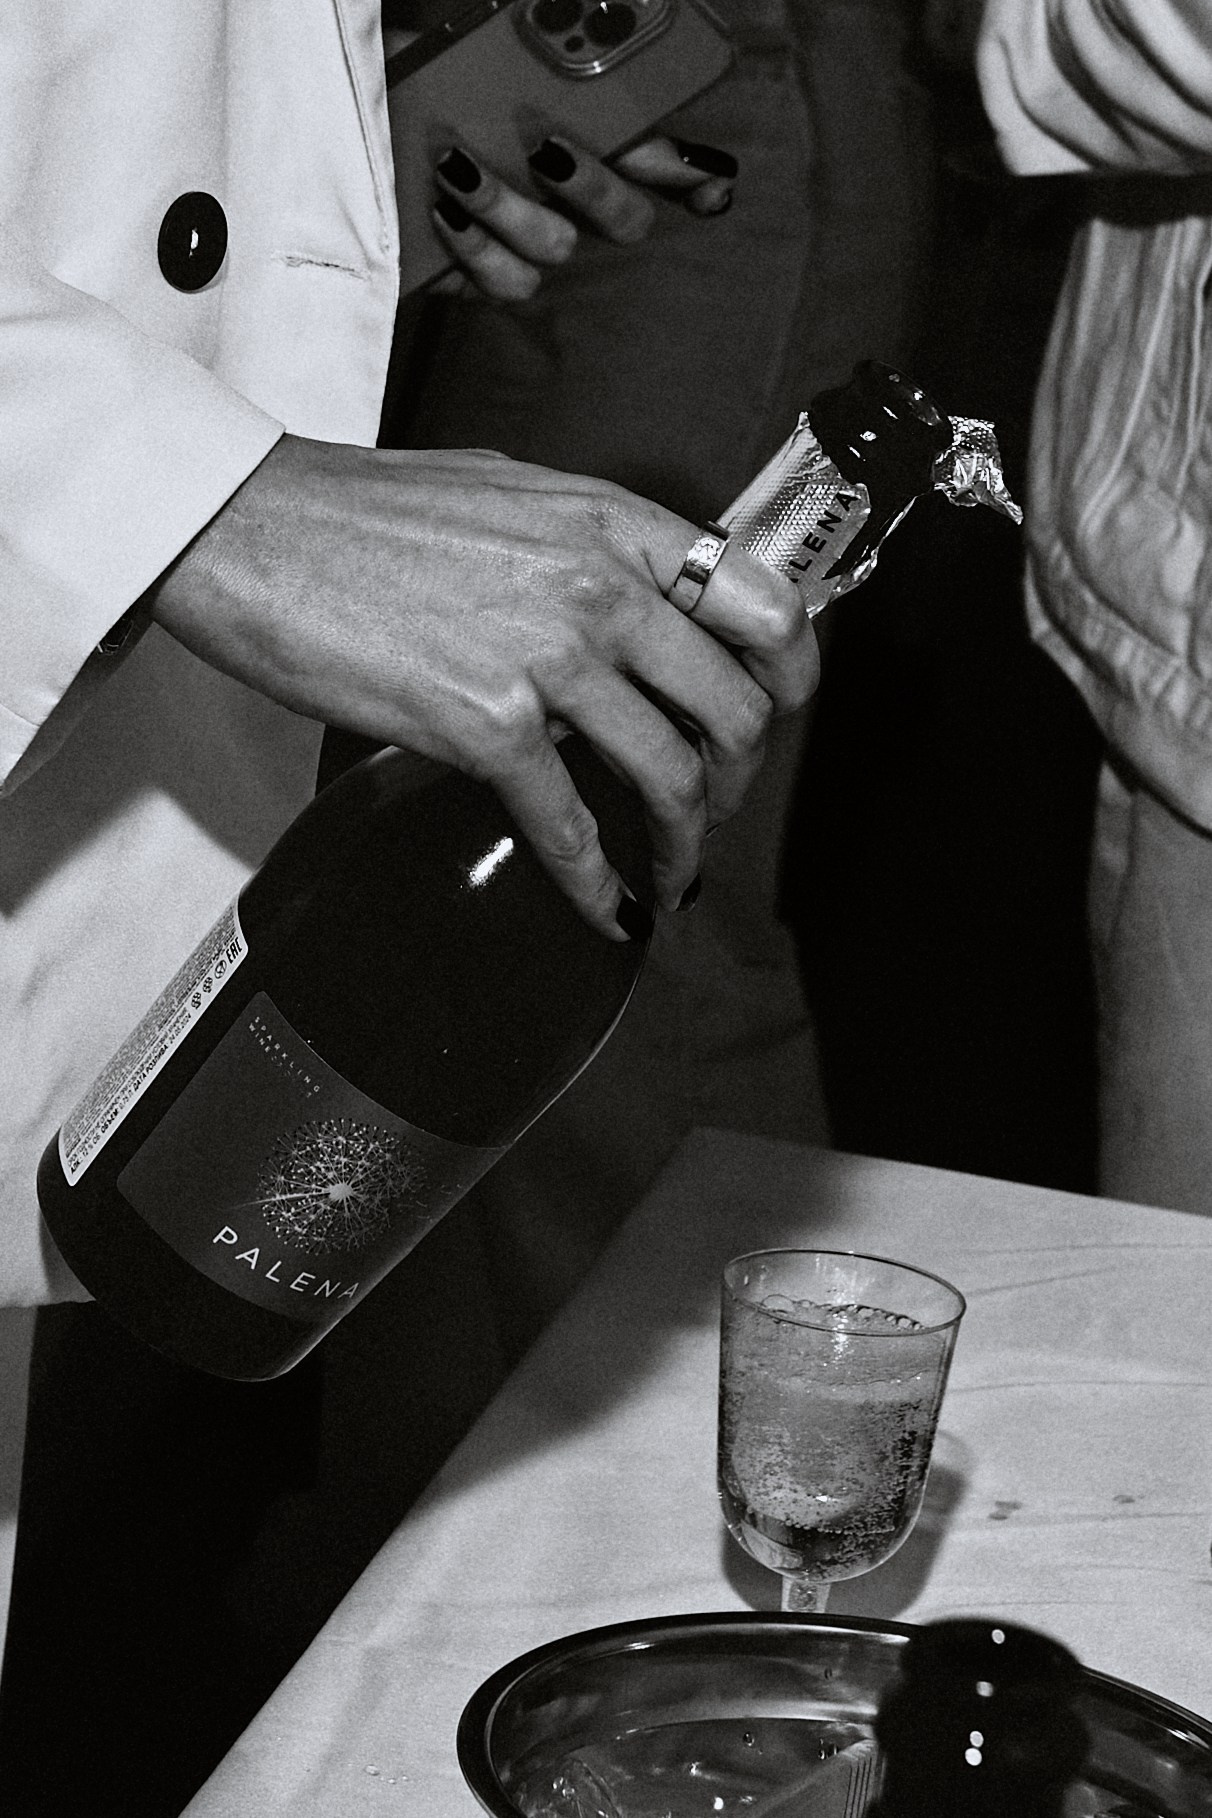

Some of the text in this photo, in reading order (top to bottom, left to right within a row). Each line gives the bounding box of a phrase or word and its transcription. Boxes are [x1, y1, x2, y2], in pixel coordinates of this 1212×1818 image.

[249, 1022, 271, 1053] WINE
[254, 1016, 320, 1093] SPARKLING
[213, 1226, 359, 1299] PALENA
